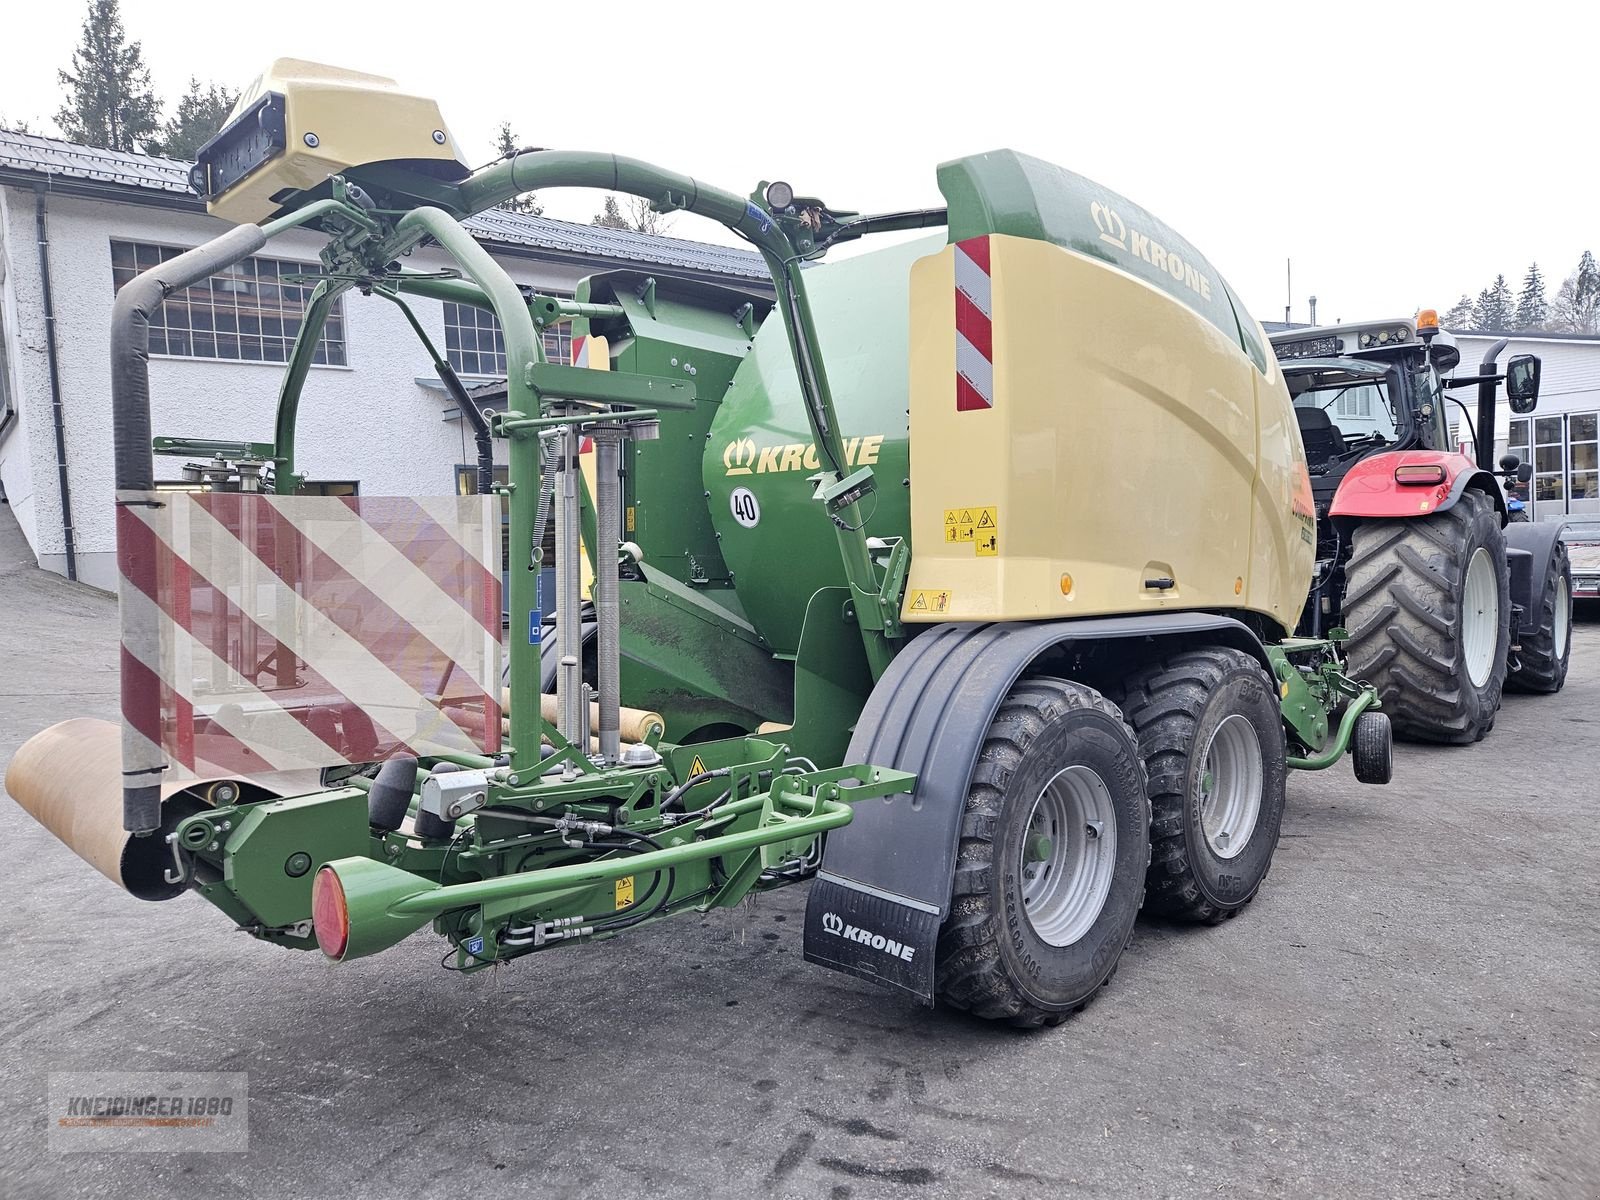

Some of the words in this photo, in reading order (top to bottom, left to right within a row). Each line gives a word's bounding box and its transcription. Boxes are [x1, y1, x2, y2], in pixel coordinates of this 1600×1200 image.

[1131, 229, 1212, 302] KRONE
[734, 494, 756, 521] 40
[843, 924, 916, 963] KRONE
